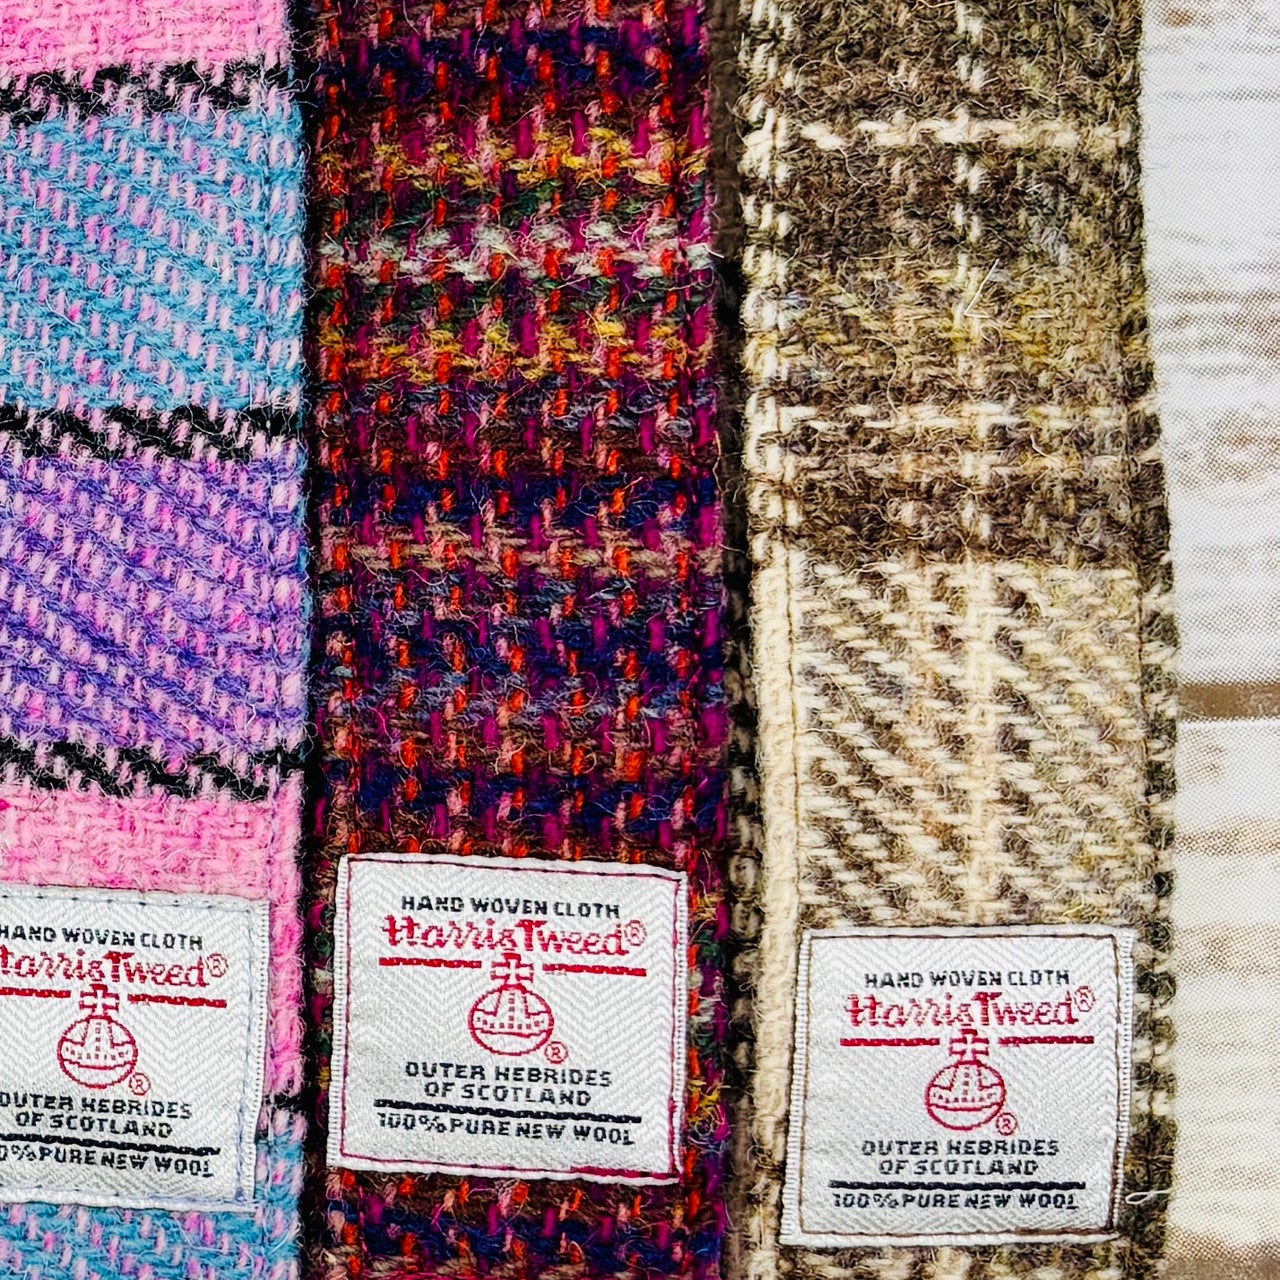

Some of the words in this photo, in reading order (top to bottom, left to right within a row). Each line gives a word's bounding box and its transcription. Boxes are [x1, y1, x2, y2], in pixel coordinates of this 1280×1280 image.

[401, 896, 464, 912] HAND
[470, 898, 548, 916] WOVEN
[553, 902, 619, 918] CLOTH
[61, 928, 135, 946] WOVEN
[140, 933, 203, 950] CLOTH
[381, 915, 516, 951] Harris
[864, 972, 923, 989] HAND
[929, 971, 1002, 987] WOVEN
[1008, 970, 1069, 986] CLOTH
[844, 993, 973, 1028] Harris
[405, 1062, 485, 1081] OUTER
[494, 1067, 612, 1087] HEBRIDES
[424, 1082, 455, 1098] OF
[461, 1084, 591, 1106] SCOTLAND
[82, 1097, 191, 1119] HEBRIDES
[16, 1112, 45, 1128] OF
[50, 1114, 173, 1138] SCOTLAND
[378, 1112, 447, 1132] 100%
[450, 1116, 510, 1137] PURE
[517, 1122, 566, 1139] NEW
[573, 1126, 634, 1145] WOOL
[862, 1140, 939, 1156] OUTER
[947, 1139, 1059, 1156] HEBRIDES
[40, 1147, 95, 1166] PURE
[101, 1154, 149, 1170] NEW
[155, 1158, 215, 1177] WOOL
[879, 1160, 906, 1175] OF
[917, 1159, 1039, 1175] SCOTLAND
[832, 1193, 898, 1209] 100%
[902, 1193, 959, 1208] PURE
[965, 1194, 1014, 1209] NEW
[1019, 1193, 1078, 1209] WOOL
